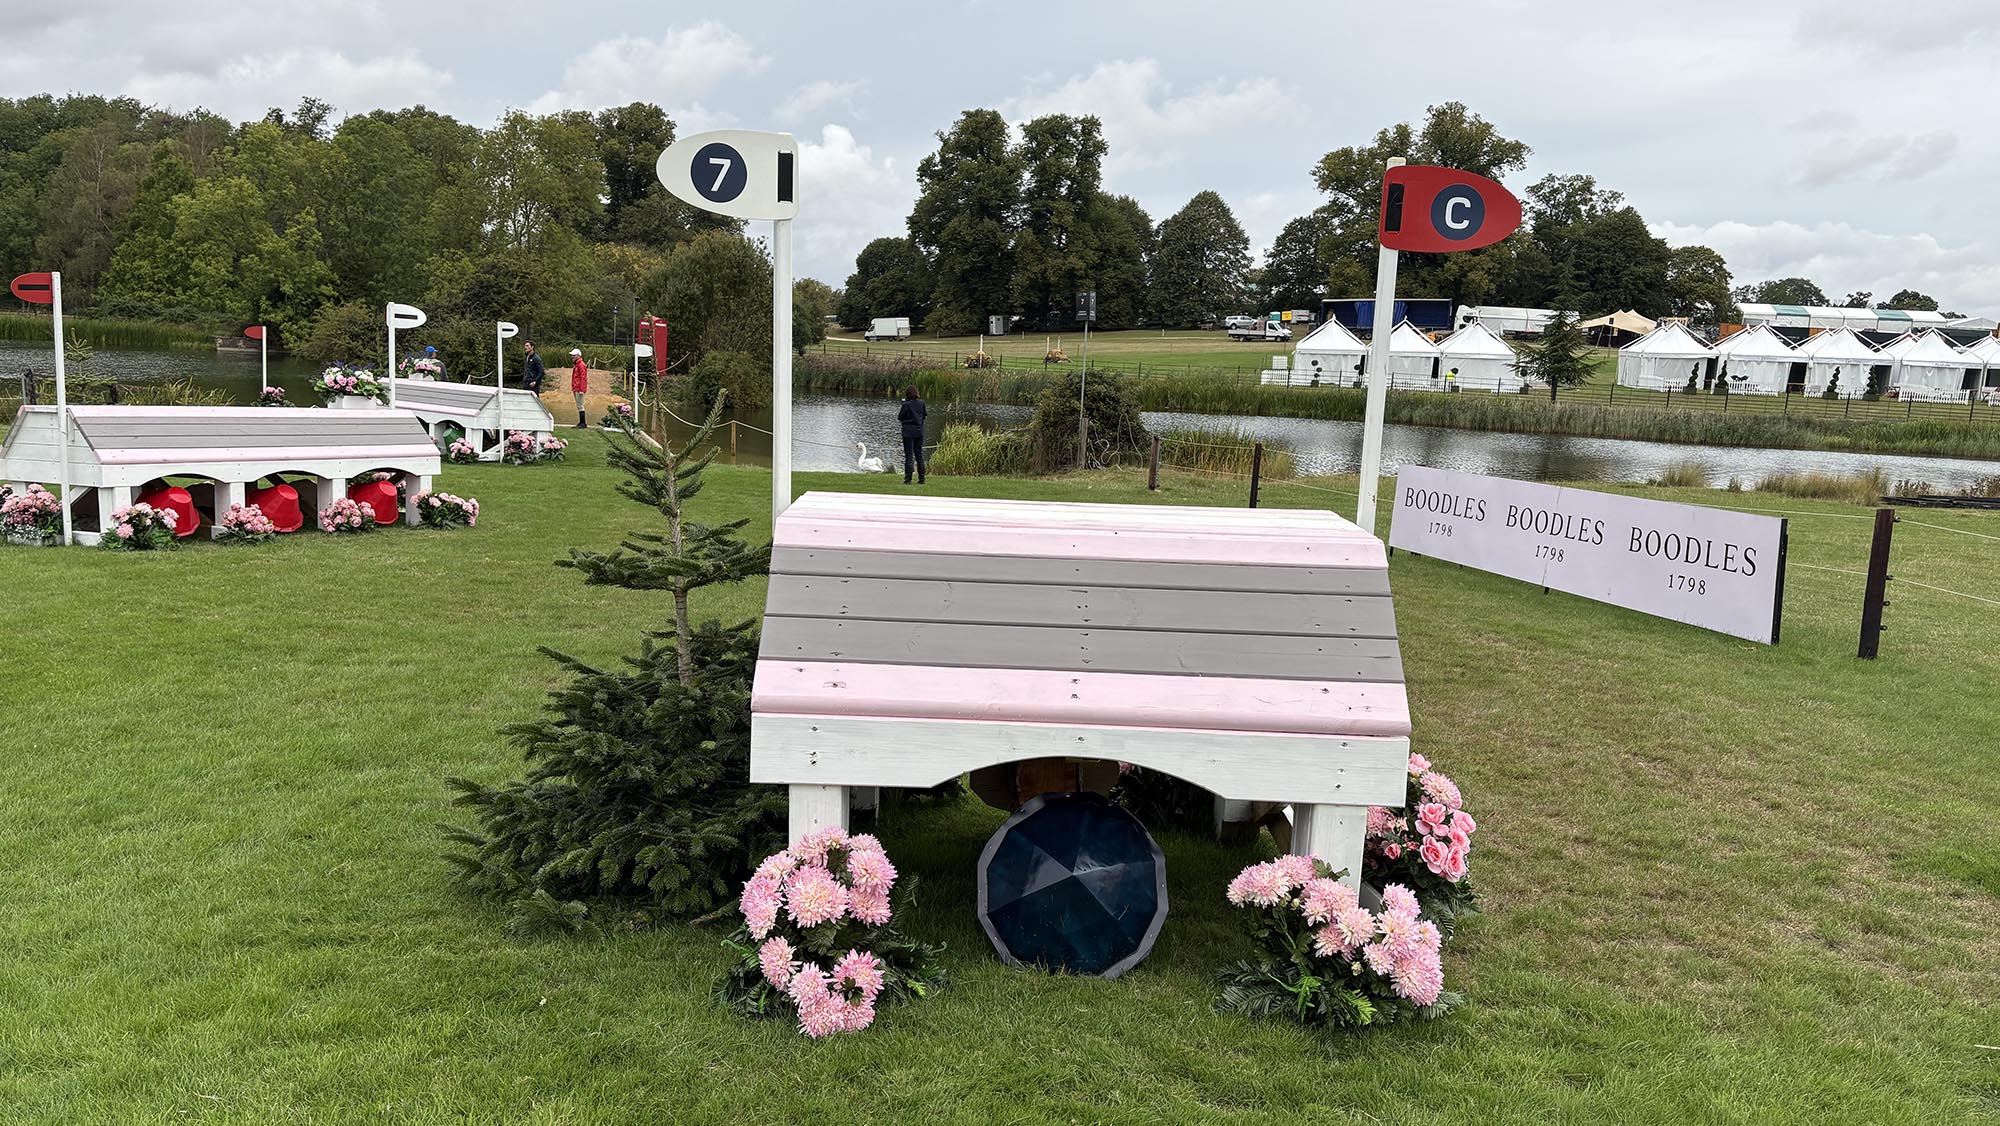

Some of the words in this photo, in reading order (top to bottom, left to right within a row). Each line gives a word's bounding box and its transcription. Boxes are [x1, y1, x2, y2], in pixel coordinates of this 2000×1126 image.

[709, 157, 731, 192] 7
[1445, 196, 1471, 230] C
[1404, 487, 1487, 522] BOODLES
[1428, 521, 1453, 538] 1798
[1505, 504, 1605, 546] BOODLES
[1535, 544, 1565, 563] 1798
[1628, 526, 1758, 577] BOODLES
[1668, 573, 1706, 596] 1798
